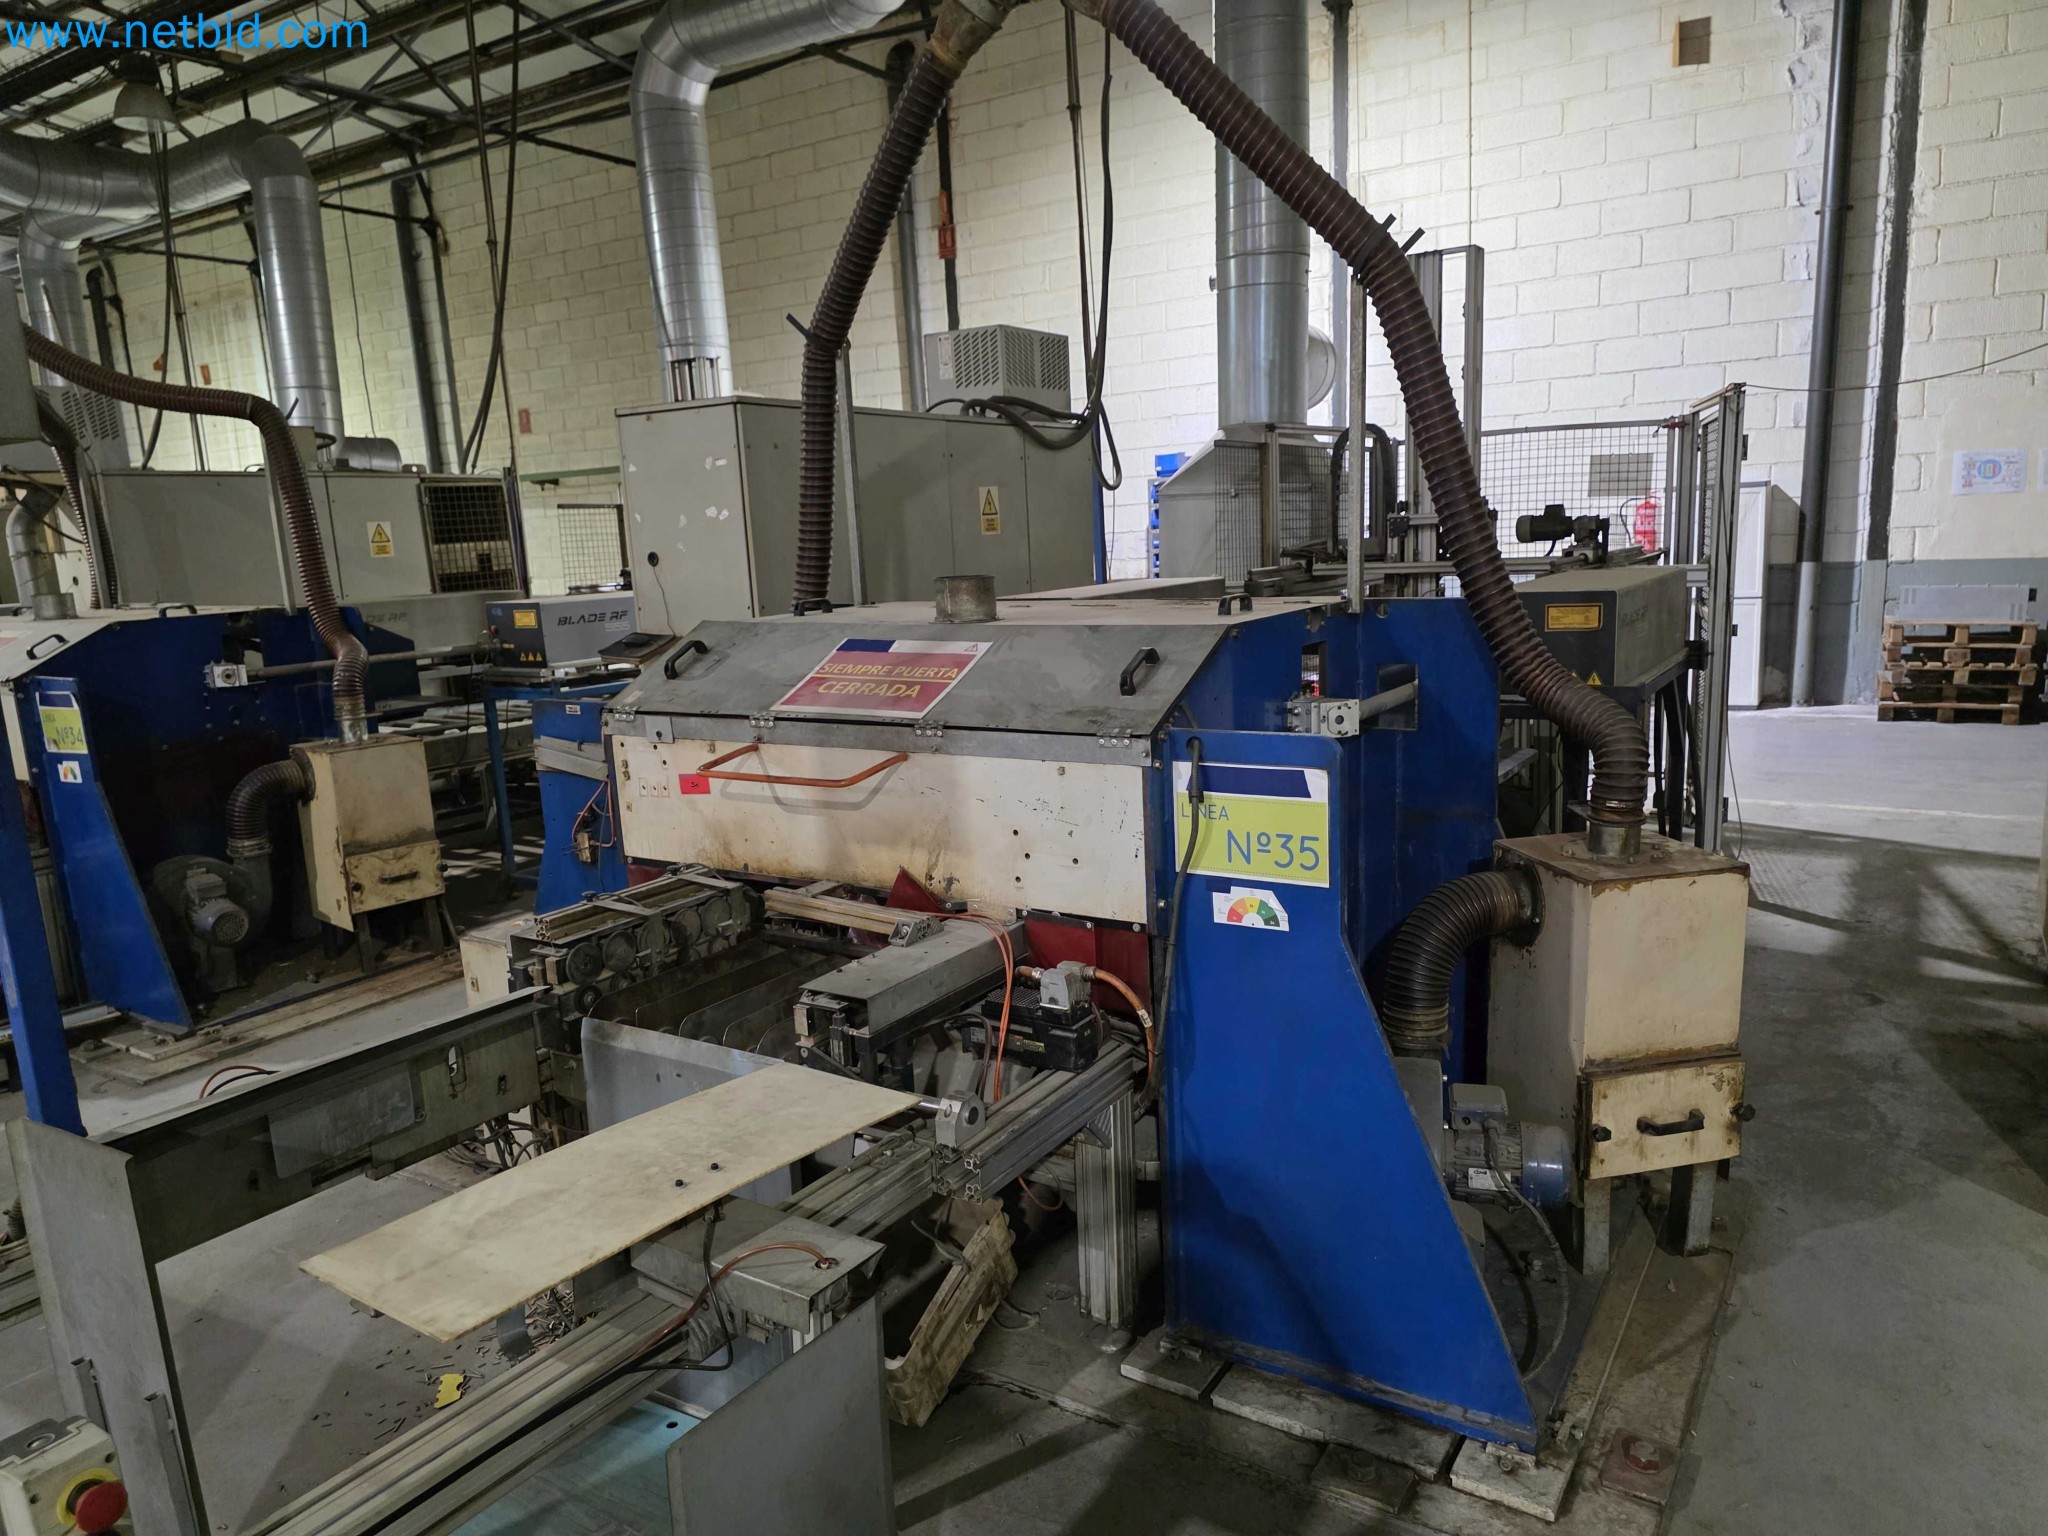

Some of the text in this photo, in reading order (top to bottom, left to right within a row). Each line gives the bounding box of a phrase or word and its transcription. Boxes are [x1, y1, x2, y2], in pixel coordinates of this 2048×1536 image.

[557, 610, 628, 626] BLADE RF
[819, 663, 959, 679] SIEMPRE PUERTA
[817, 681, 921, 698] CERRADA
[1181, 802, 1229, 821] LNEA
[1226, 829, 1320, 871] Nº35
